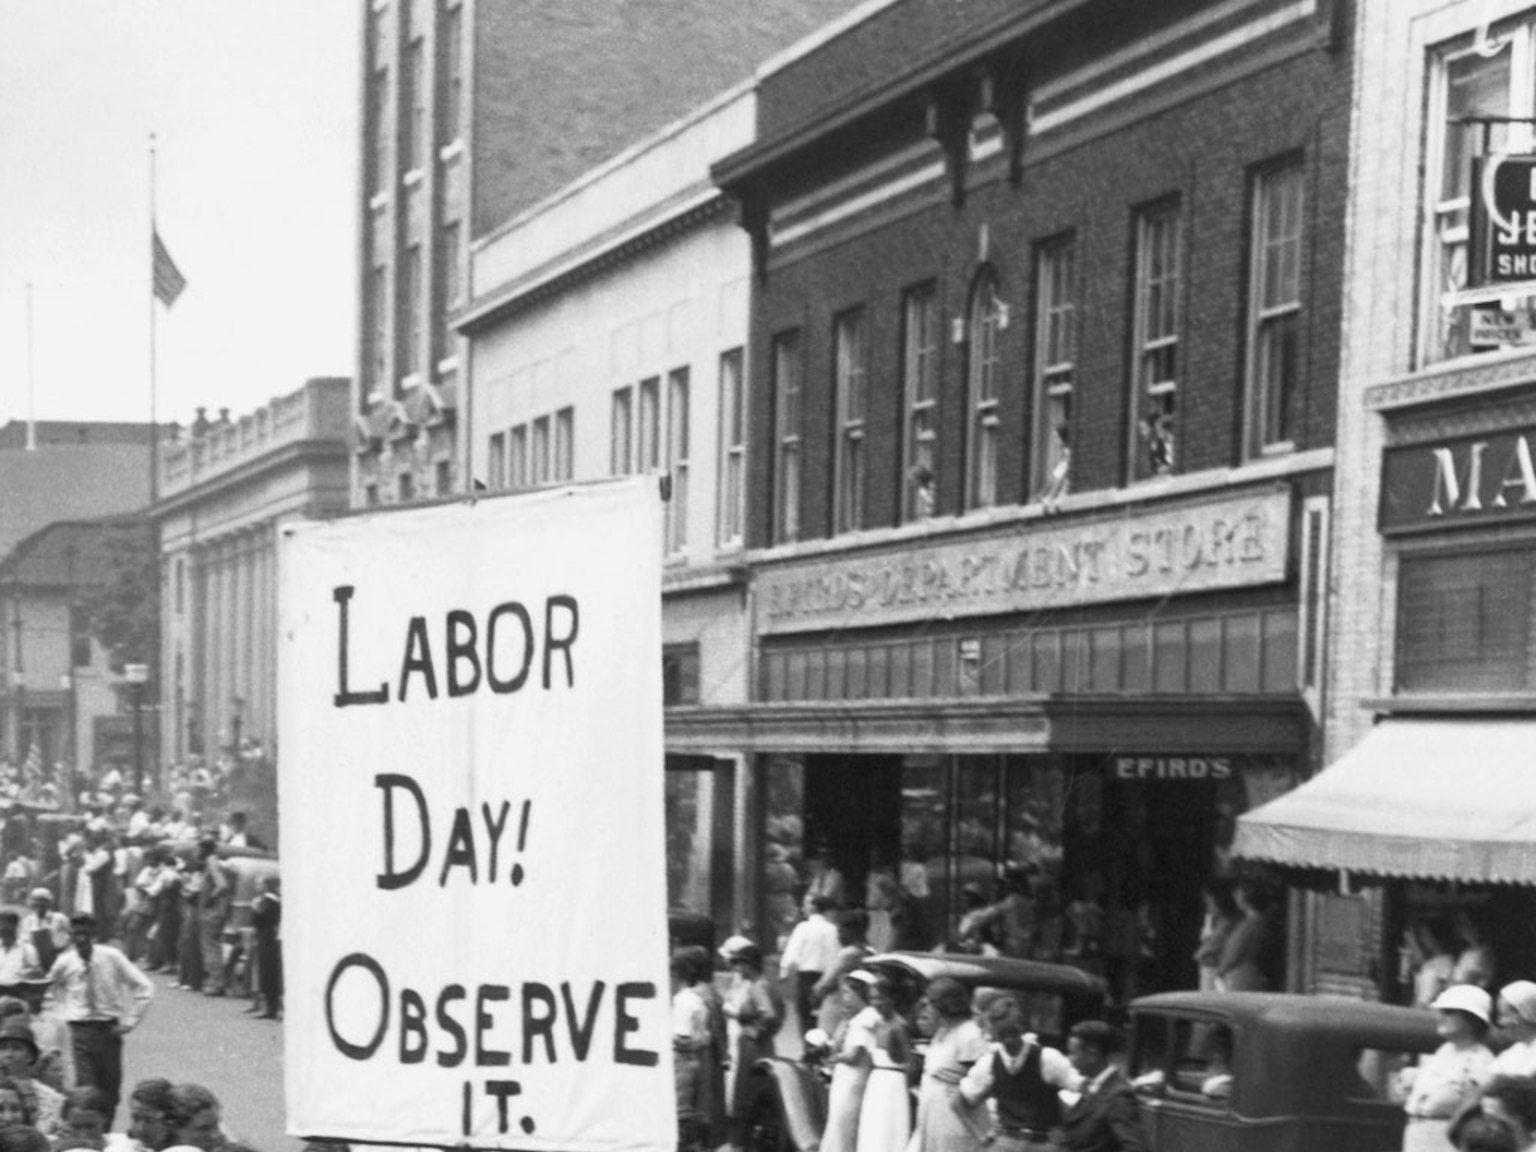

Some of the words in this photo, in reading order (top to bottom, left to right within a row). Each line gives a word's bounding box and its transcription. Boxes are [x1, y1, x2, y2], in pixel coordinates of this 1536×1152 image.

[1125, 514, 1267, 578] STORE
[332, 585, 579, 708] LABOR
[375, 773, 532, 889] DAY!
[325, 952, 659, 1068] OBSERVE
[464, 1080, 537, 1135] IT.
